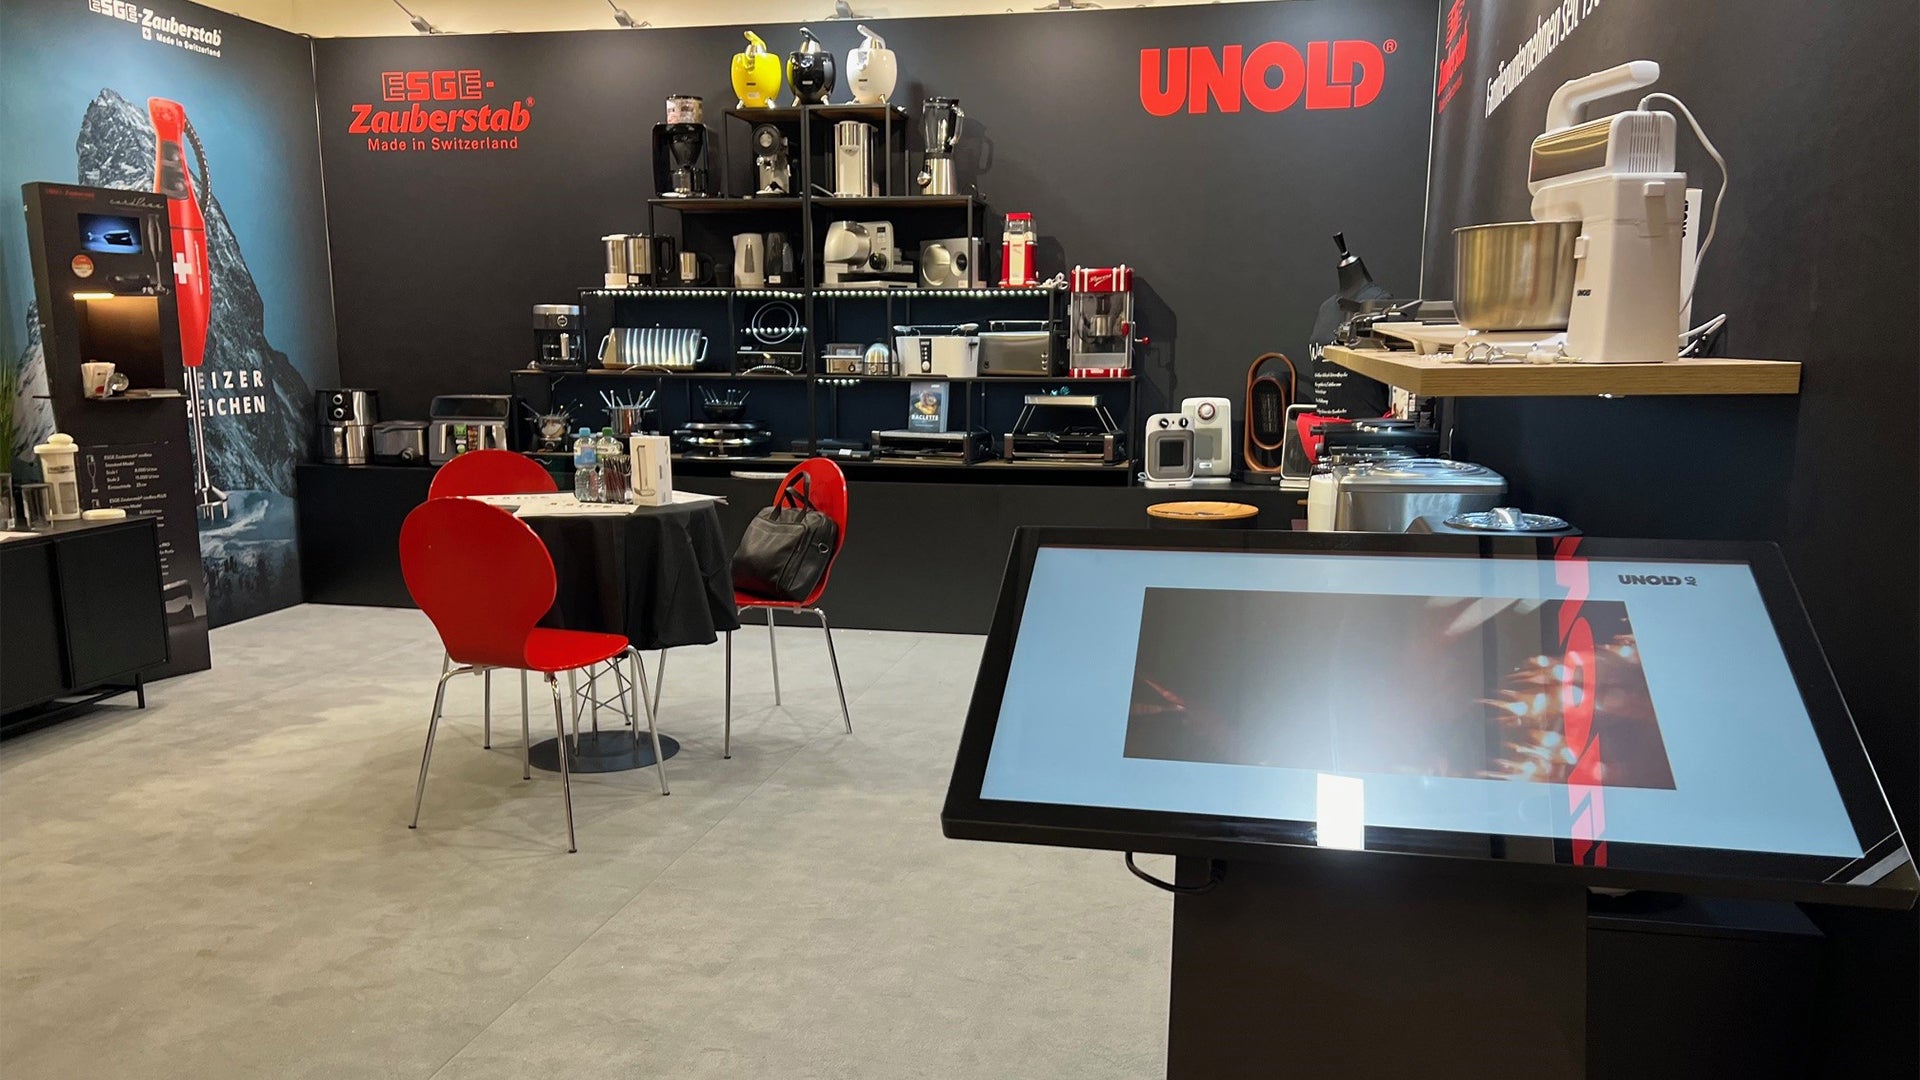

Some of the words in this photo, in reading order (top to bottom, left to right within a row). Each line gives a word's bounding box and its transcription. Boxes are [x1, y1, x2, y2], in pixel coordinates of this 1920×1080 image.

[367, 137, 407, 151] Made
[412, 138, 426, 150] in
[431, 136, 518, 150] Switzerland
[1618, 574, 1682, 586] UNOLD
